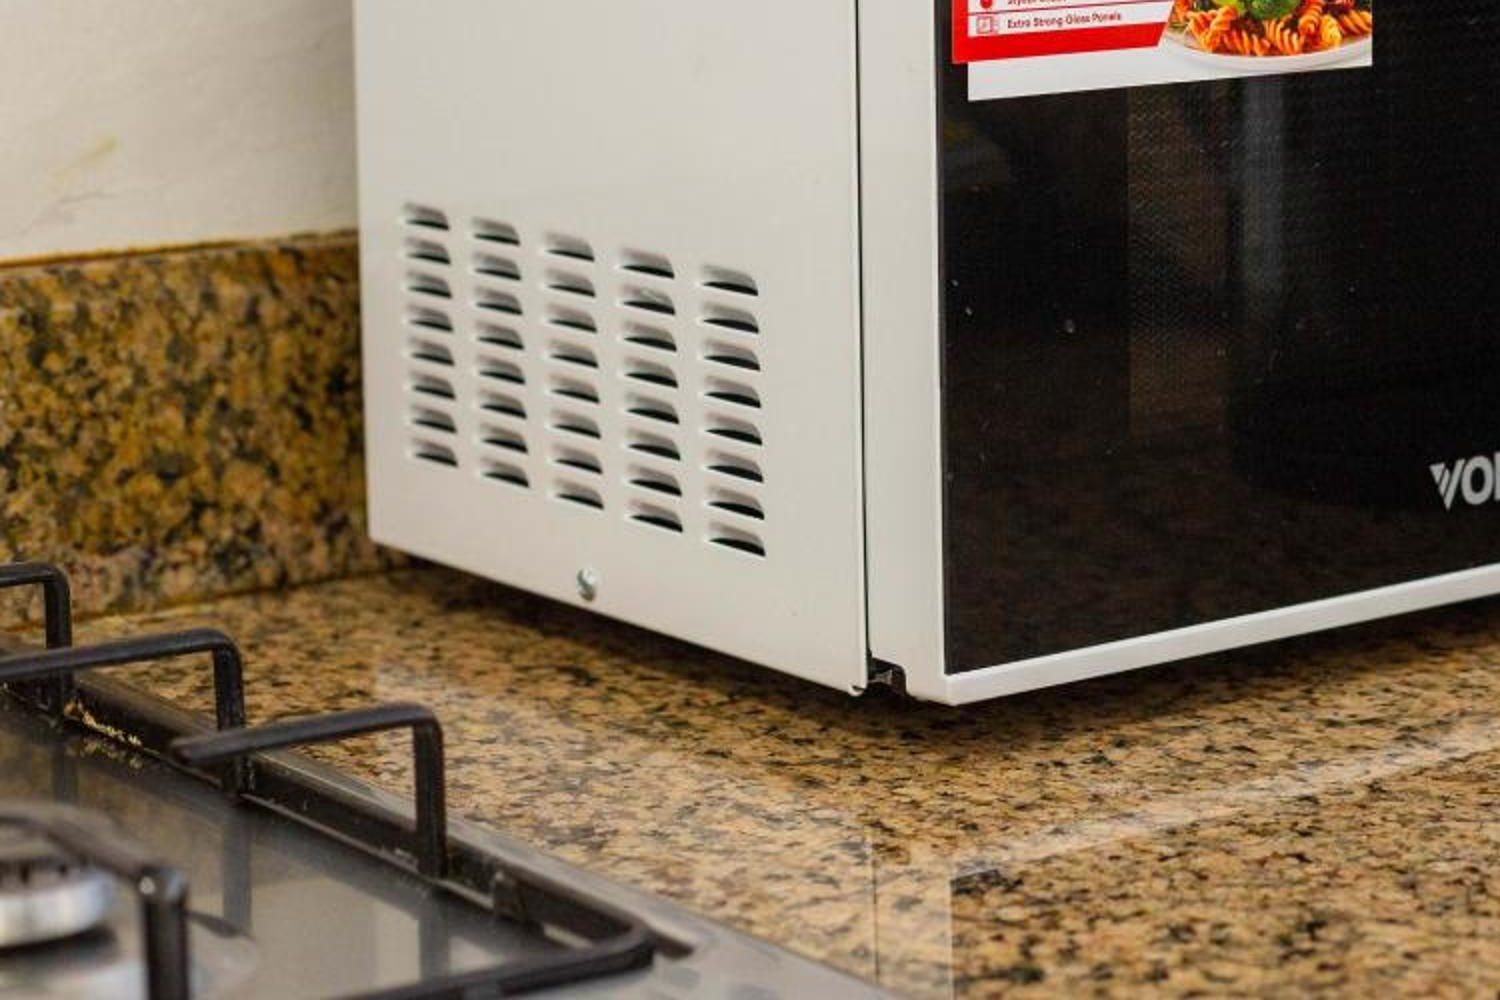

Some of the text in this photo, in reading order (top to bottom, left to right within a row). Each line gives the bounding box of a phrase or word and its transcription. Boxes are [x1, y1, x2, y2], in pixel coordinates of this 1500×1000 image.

[1007, 11, 1121, 29] Extra Strong Glass Panels
